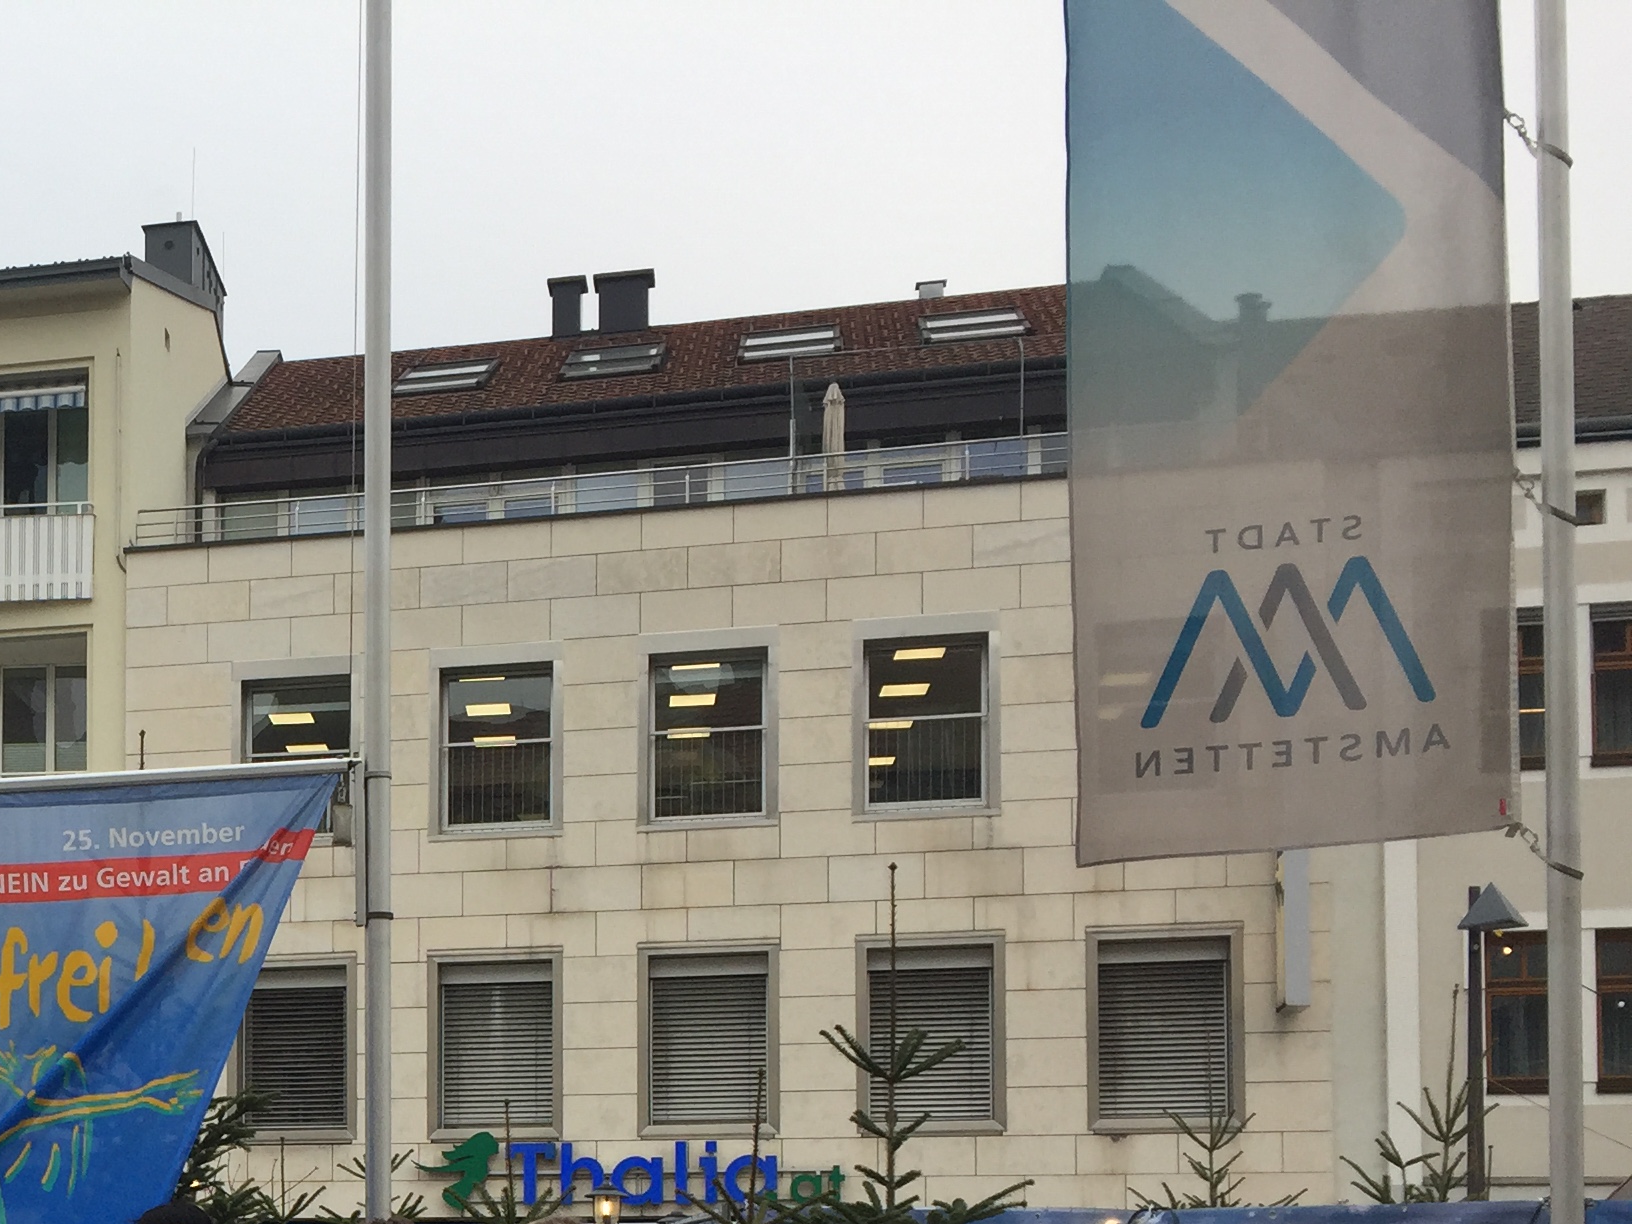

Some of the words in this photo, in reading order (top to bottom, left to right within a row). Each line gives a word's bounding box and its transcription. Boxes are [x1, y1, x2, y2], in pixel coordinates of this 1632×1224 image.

[62, 829, 100, 852] 25.
[108, 823, 246, 849] November
[58, 873, 88, 892] zu
[96, 863, 190, 889] Gewalt
[198, 864, 230, 884] an
